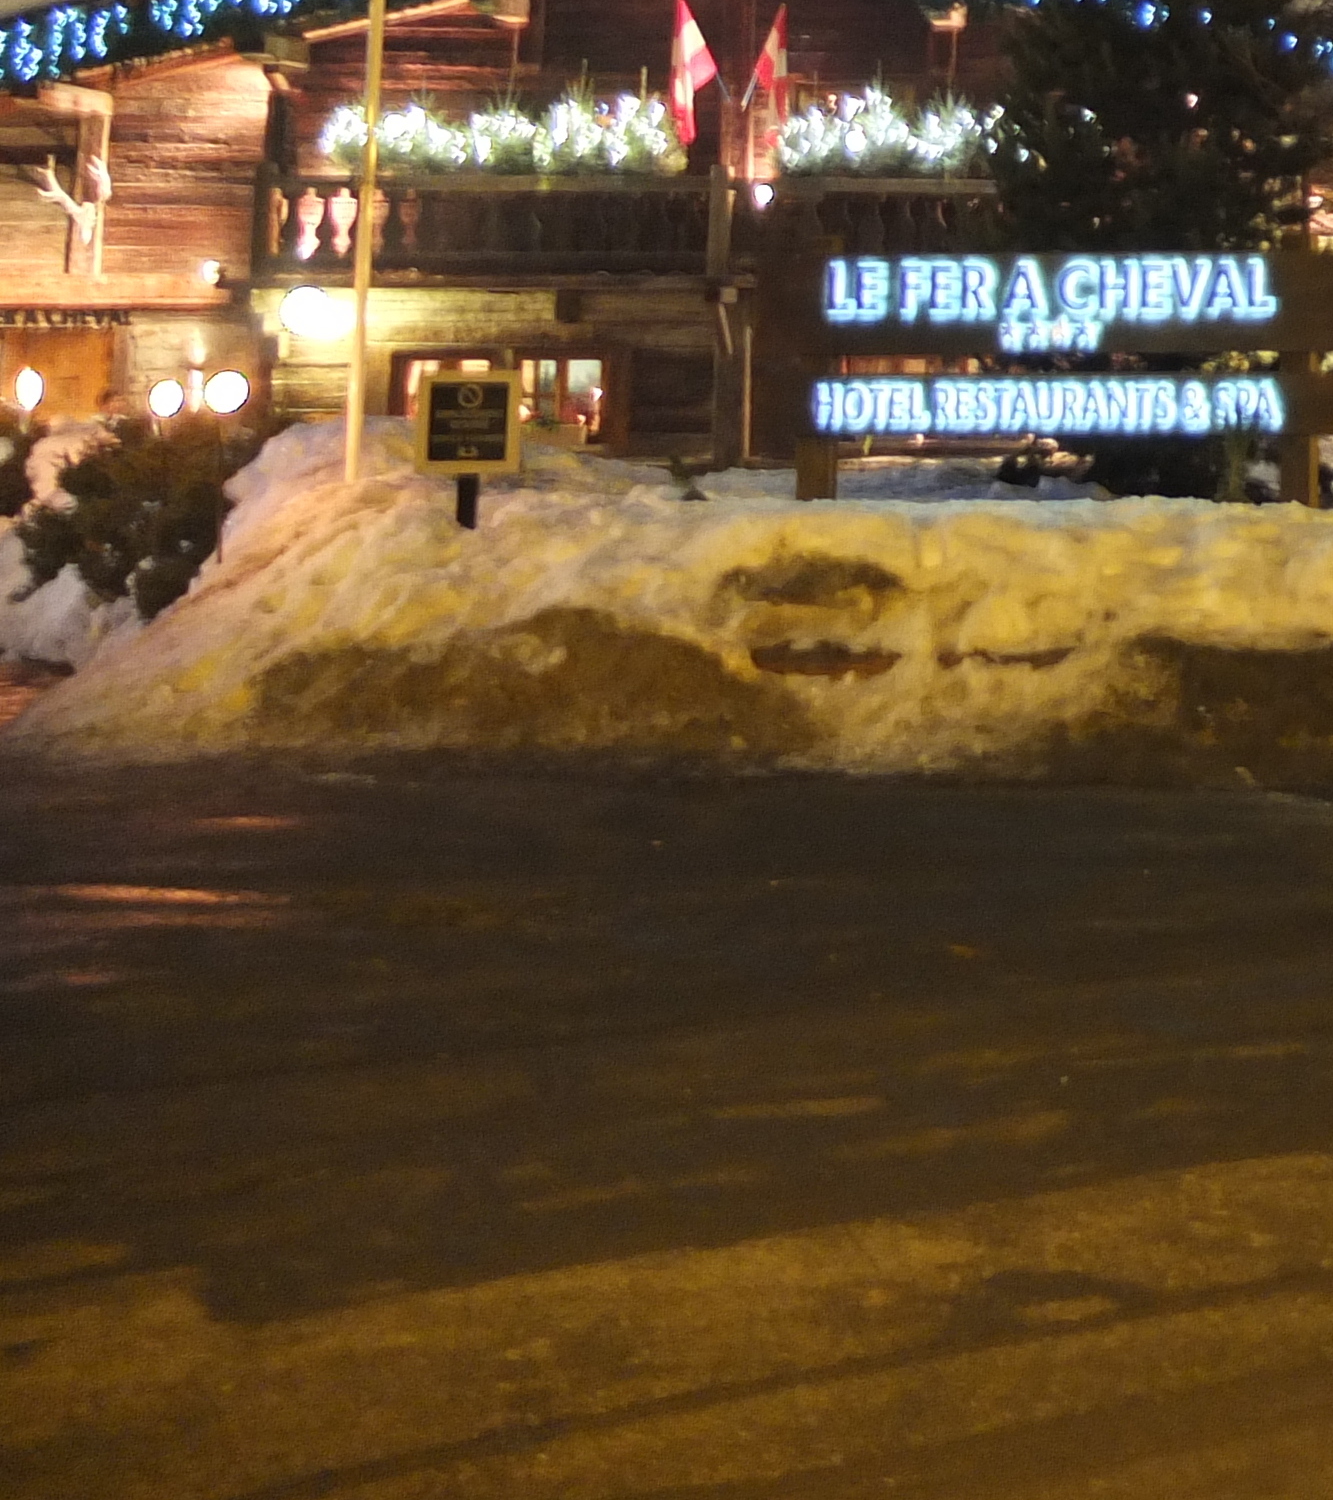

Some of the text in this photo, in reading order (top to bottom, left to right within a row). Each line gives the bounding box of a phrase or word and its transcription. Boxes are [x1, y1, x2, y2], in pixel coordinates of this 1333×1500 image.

[826, 258, 889, 322] LE
[897, 258, 998, 323] FER
[1056, 258, 1278, 322] CHEVAL
[815, 380, 1285, 433] HOTEL RESTAURANTS & SPA
